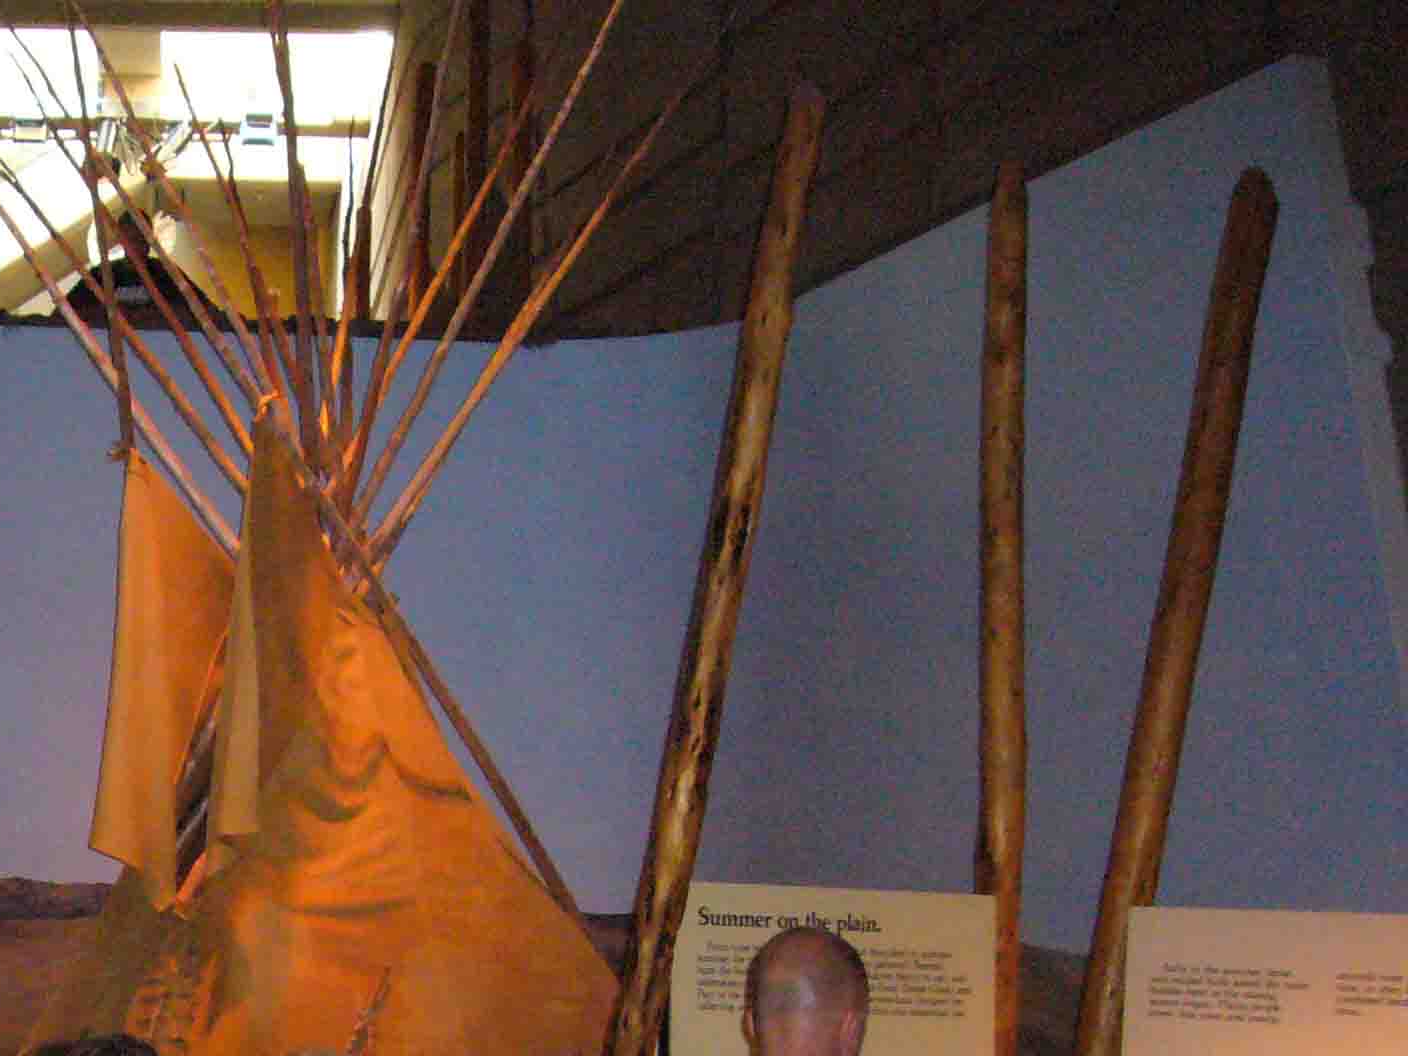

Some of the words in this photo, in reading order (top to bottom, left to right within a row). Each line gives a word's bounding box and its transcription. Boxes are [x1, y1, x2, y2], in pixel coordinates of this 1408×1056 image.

[698, 905, 770, 928] Summer
[777, 915, 799, 929] on
[806, 911, 832, 929] the
